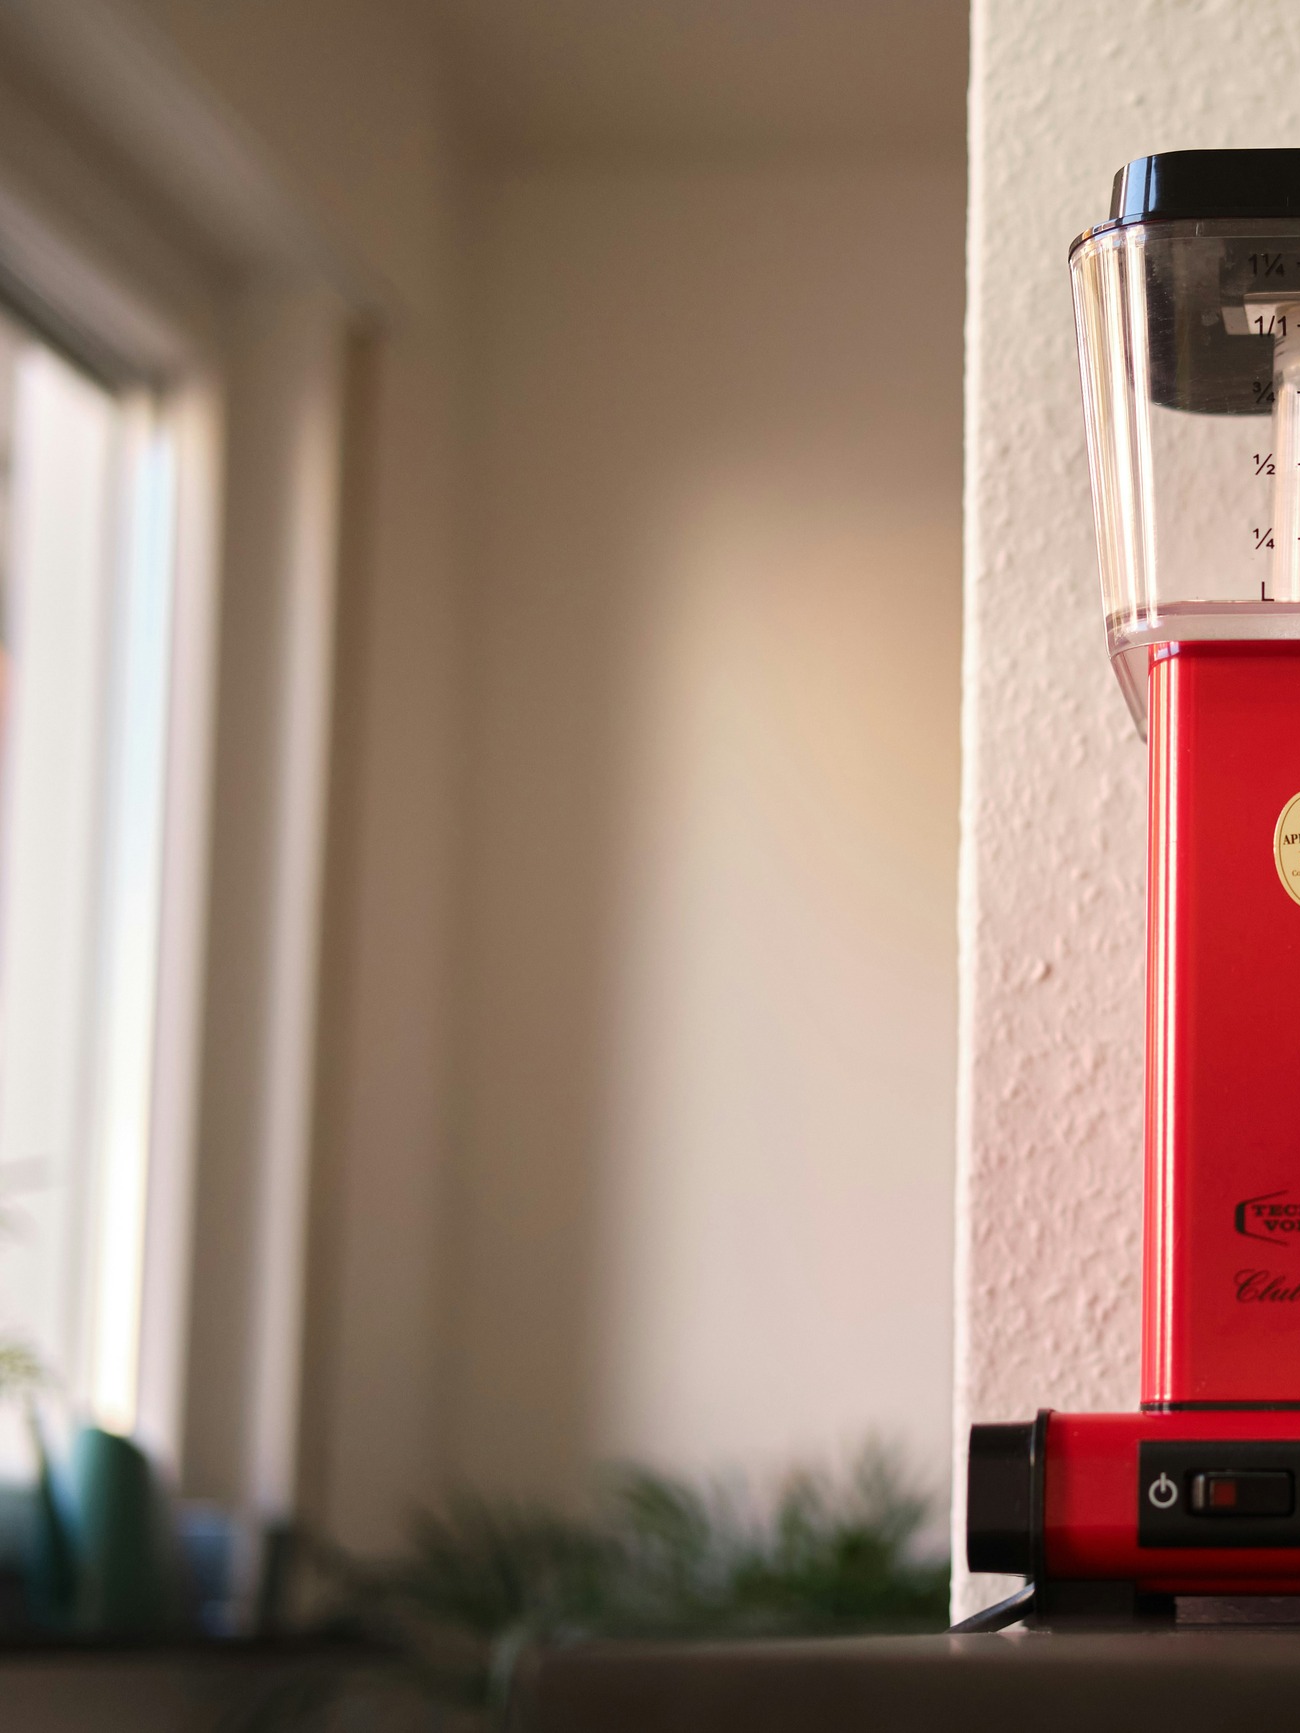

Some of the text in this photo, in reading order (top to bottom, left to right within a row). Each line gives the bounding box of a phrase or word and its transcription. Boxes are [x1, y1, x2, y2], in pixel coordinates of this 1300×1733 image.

[1248, 253, 1285, 277] 1¼
[1254, 315, 1287, 337] 1/1
[1252, 381, 1276, 404] ¾
[1253, 453, 1276, 476] ½
[1253, 528, 1275, 550] ¼
[1261, 581, 1275, 602] L
